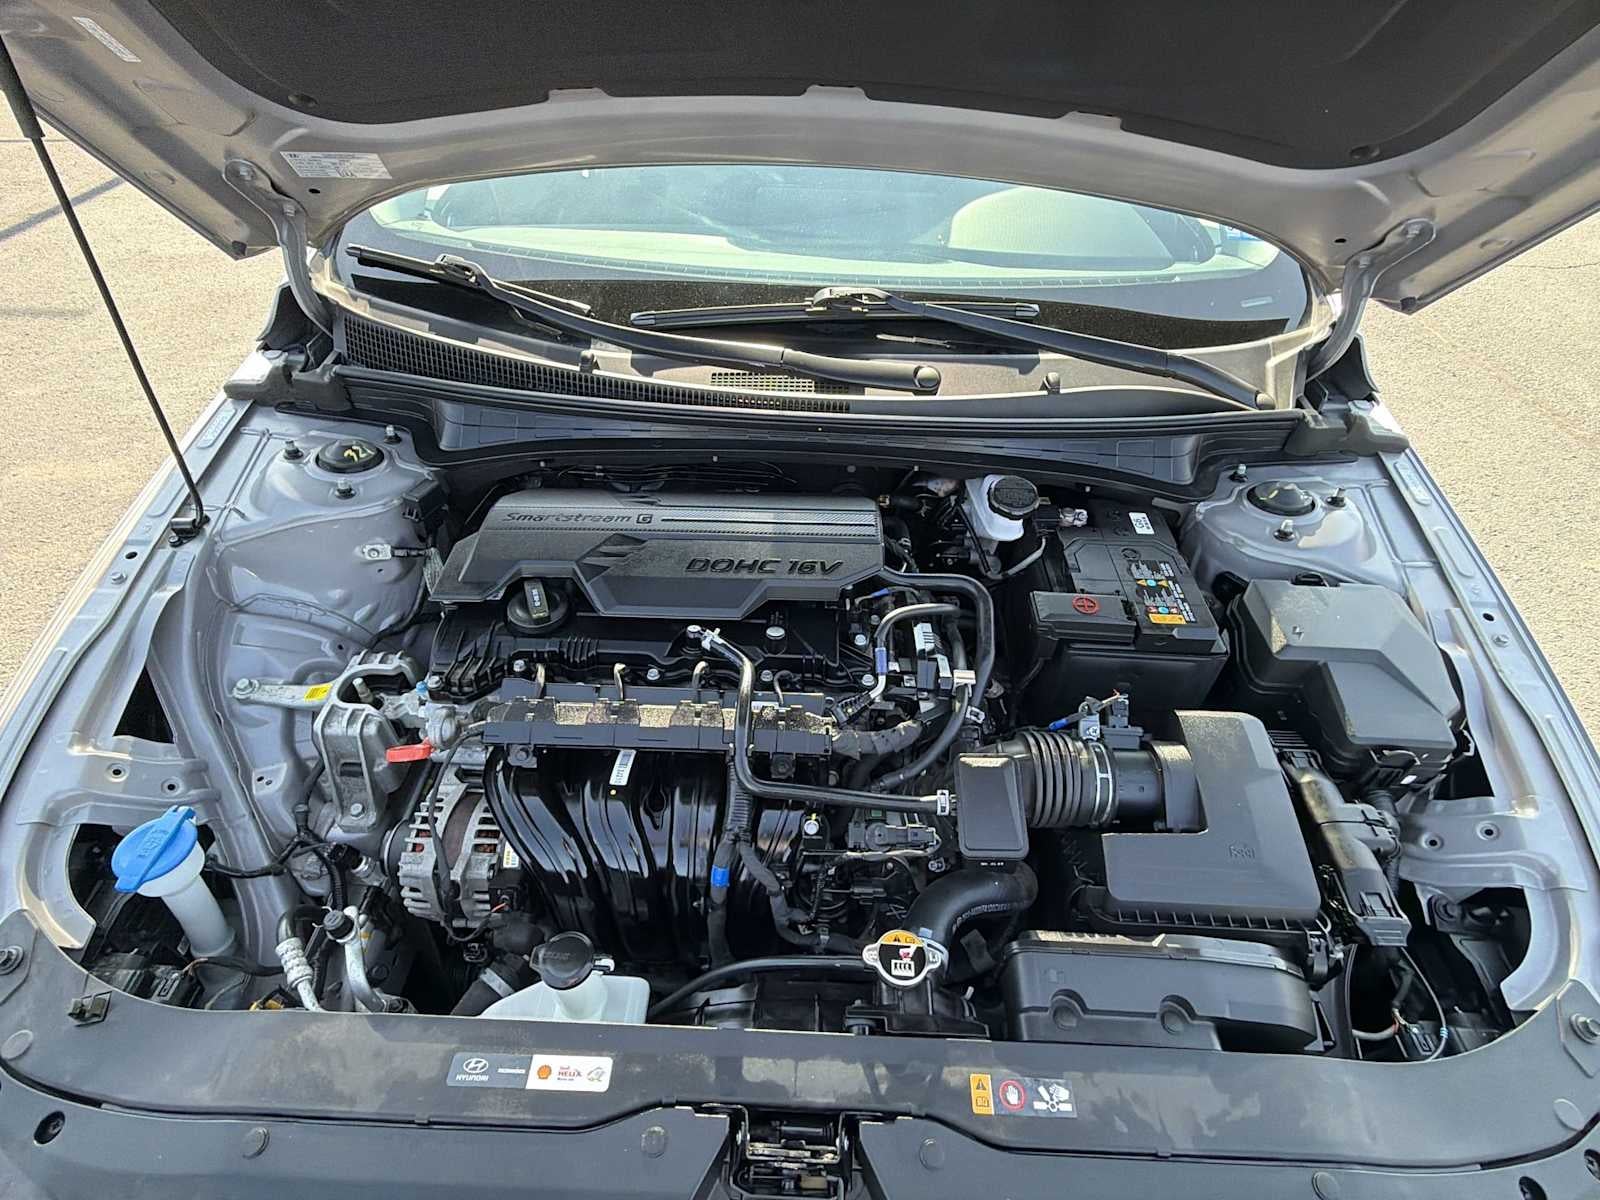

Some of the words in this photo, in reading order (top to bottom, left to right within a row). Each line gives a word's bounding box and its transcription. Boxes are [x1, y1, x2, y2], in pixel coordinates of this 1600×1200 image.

[501, 512, 633, 523] Smartstream
[685, 557, 782, 575] DOHC
[787, 558, 844, 576] 16V
[455, 1073, 490, 1082] HYUNDAI
